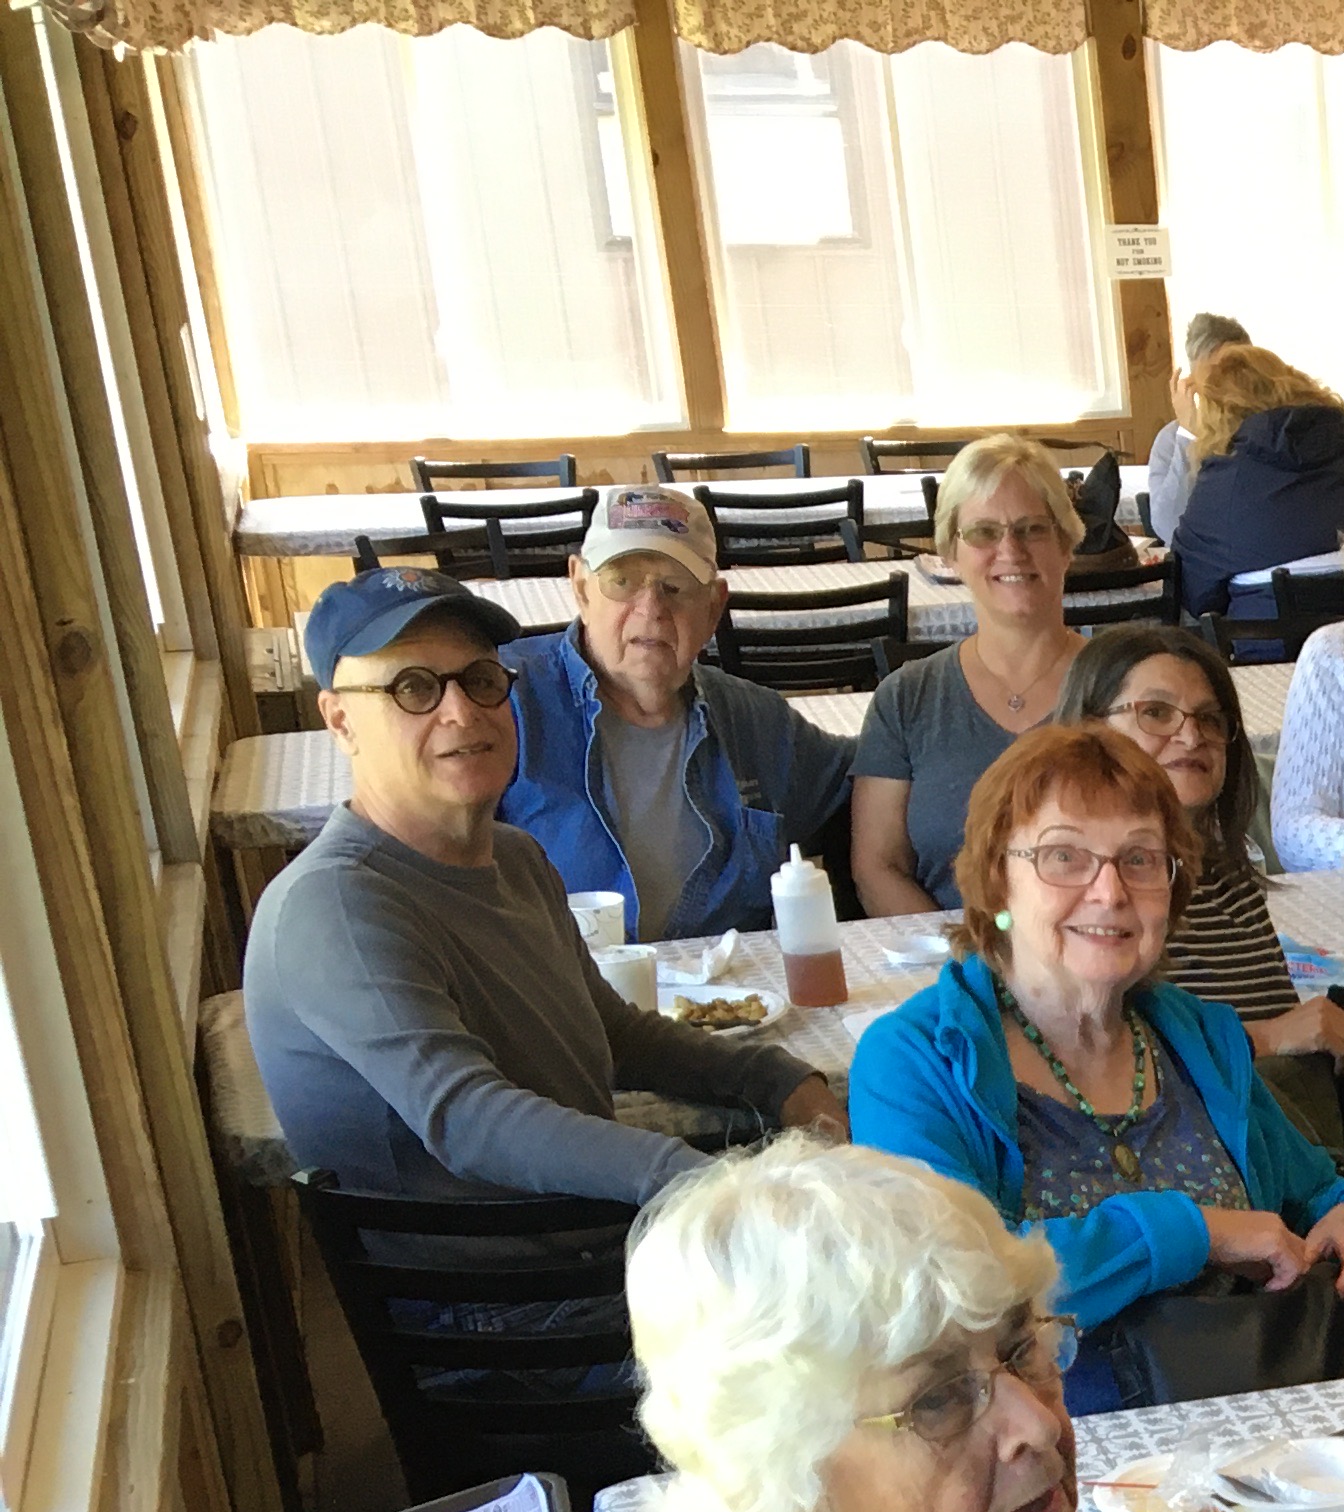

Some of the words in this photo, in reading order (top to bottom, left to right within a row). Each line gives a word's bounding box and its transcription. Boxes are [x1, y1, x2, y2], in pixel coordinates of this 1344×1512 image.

[1117, 237, 1141, 247] THANK
[1143, 237, 1157, 247] YOU
[1116, 258, 1129, 267] NOT
[1132, 257, 1163, 266] SMOKING
